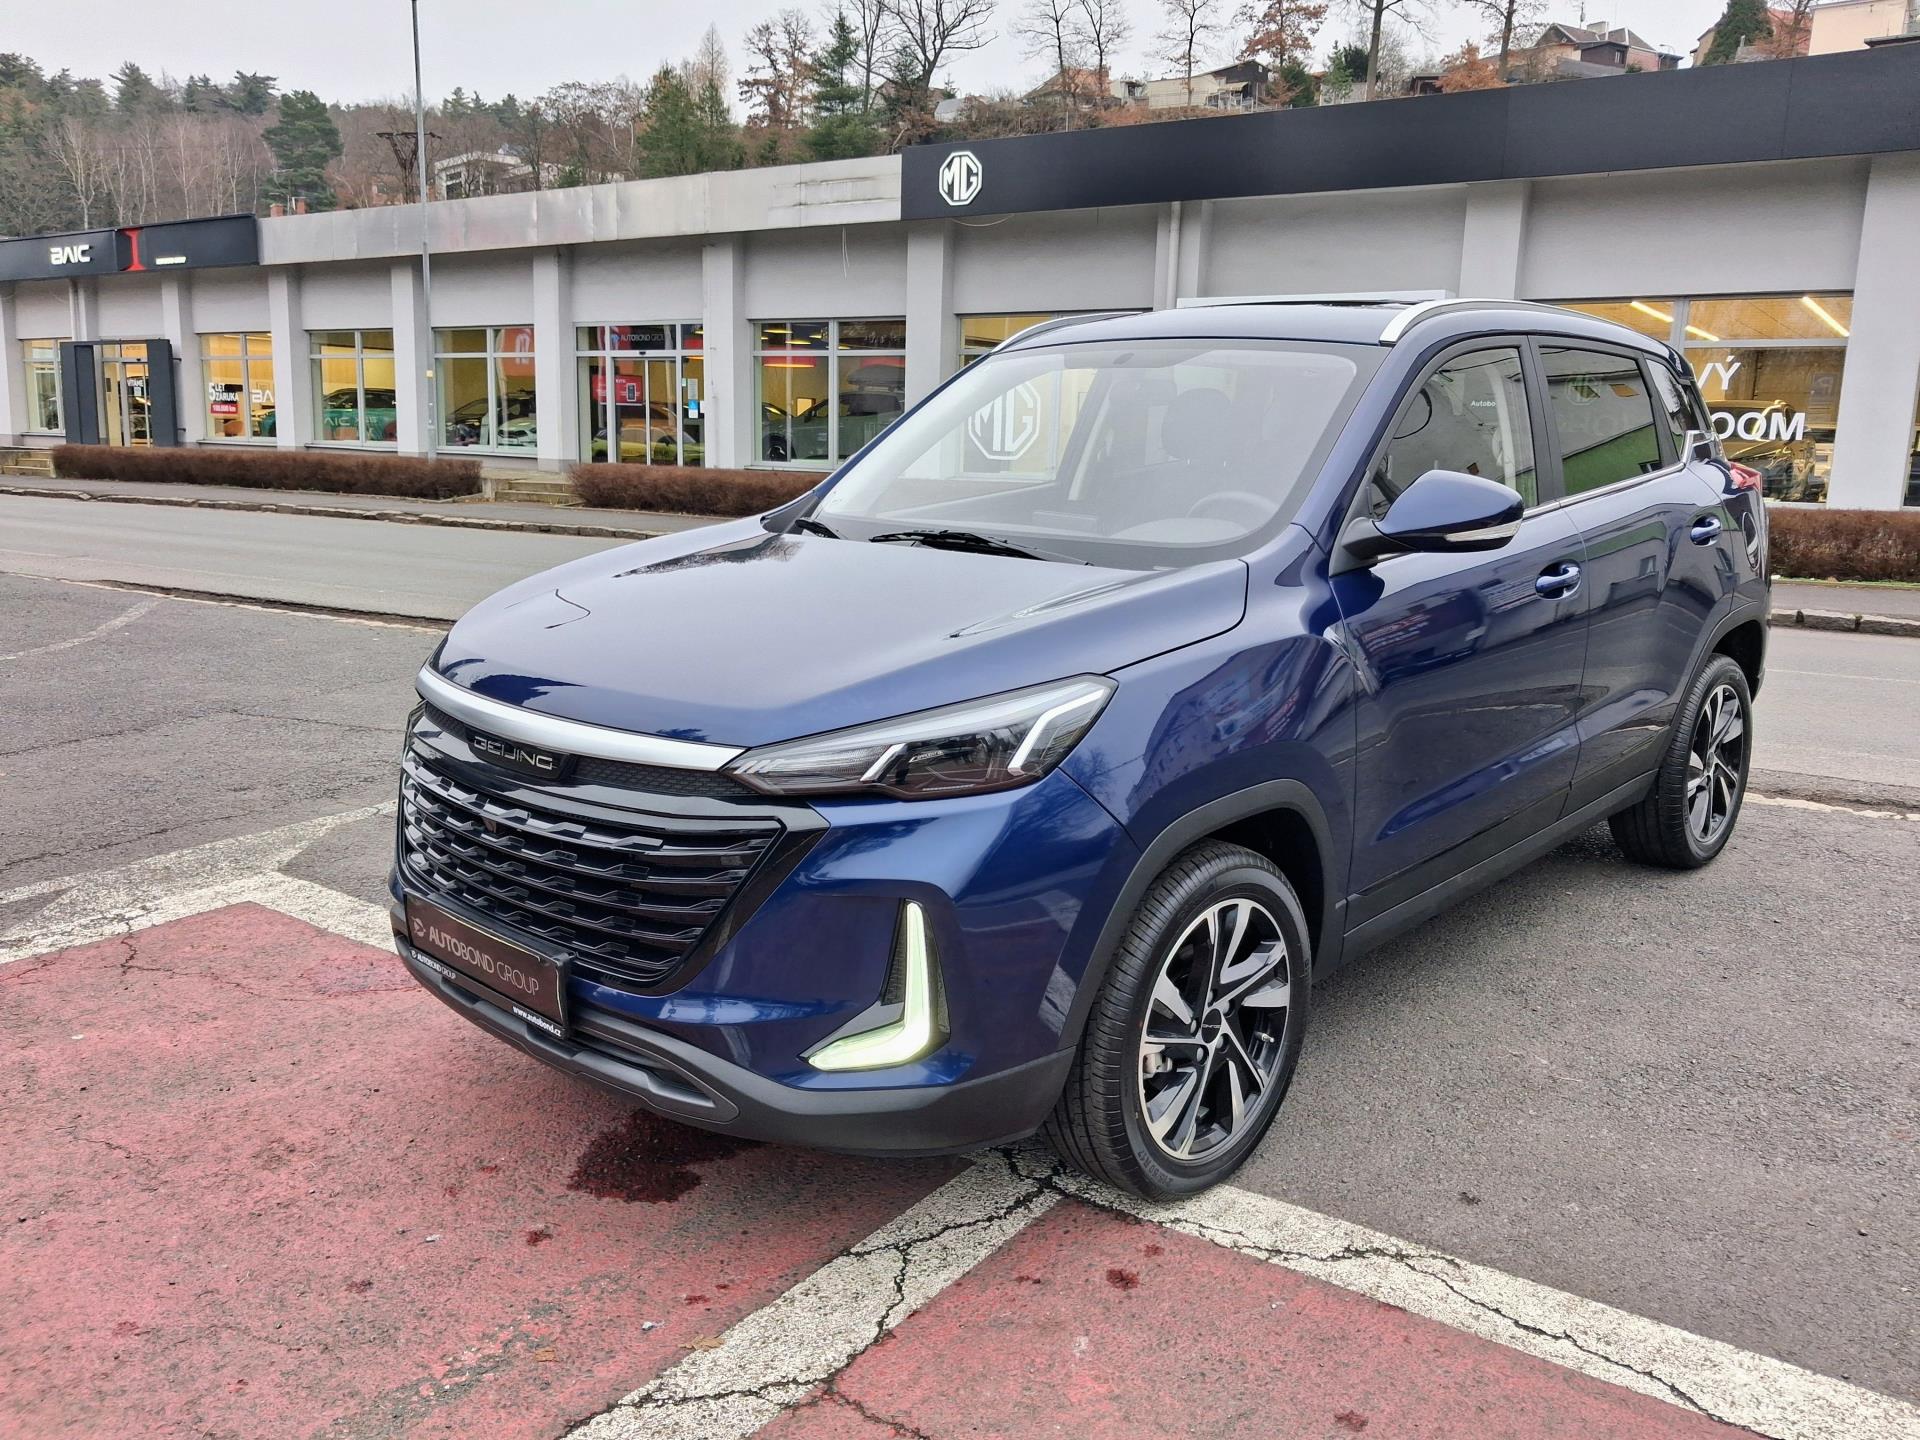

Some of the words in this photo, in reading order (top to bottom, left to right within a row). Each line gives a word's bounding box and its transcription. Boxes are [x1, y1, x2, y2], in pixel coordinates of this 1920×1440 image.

[943, 155, 978, 201] MG
[50, 244, 91, 265] BAIC
[974, 386, 1034, 452] MG
[474, 735, 553, 771] BEIJING
[417, 953, 442, 972] AUTOBOND
[441, 966, 457, 980] GROUP
[429, 926, 495, 973] AUTOBOND
[496, 961, 539, 996] GROUP
[512, 1005, 562, 1037] www.autobond.cz
